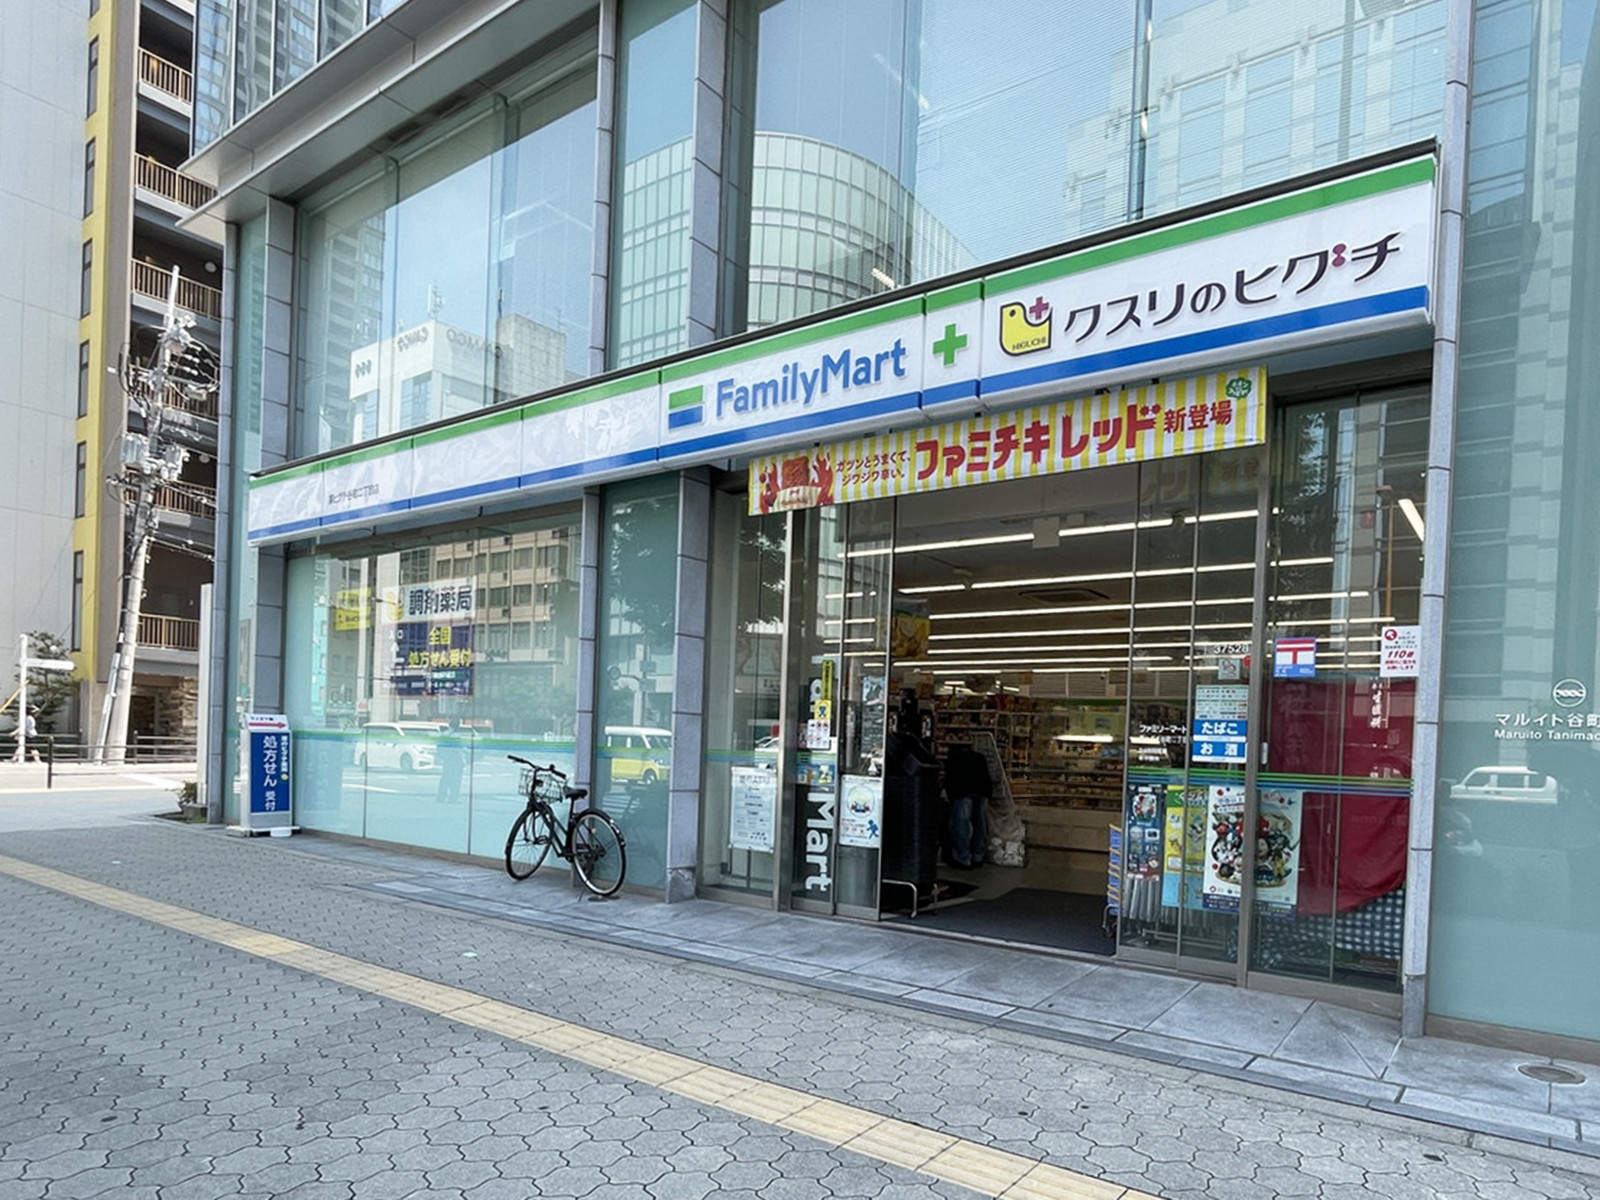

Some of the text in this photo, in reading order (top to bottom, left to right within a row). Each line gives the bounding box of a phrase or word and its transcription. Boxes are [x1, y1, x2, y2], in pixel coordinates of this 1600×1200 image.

[1064, 231, 1401, 343] クスリのヒグチ
[1011, 336, 1047, 351] HIGUCHI
[716, 338, 907, 418] FamilyMart
[1164, 399, 1233, 434] 新登場
[408, 585, 473, 616] 調剤薬局
[429, 626, 452, 645] 全国
[408, 648, 473, 668] 処方せん受付
[1201, 721, 1238, 735] たばこ
[1494, 728, 1542, 740] Maruito
[1199, 742, 1239, 756] お酒
[263, 735, 278, 811] 処方せん 受付
